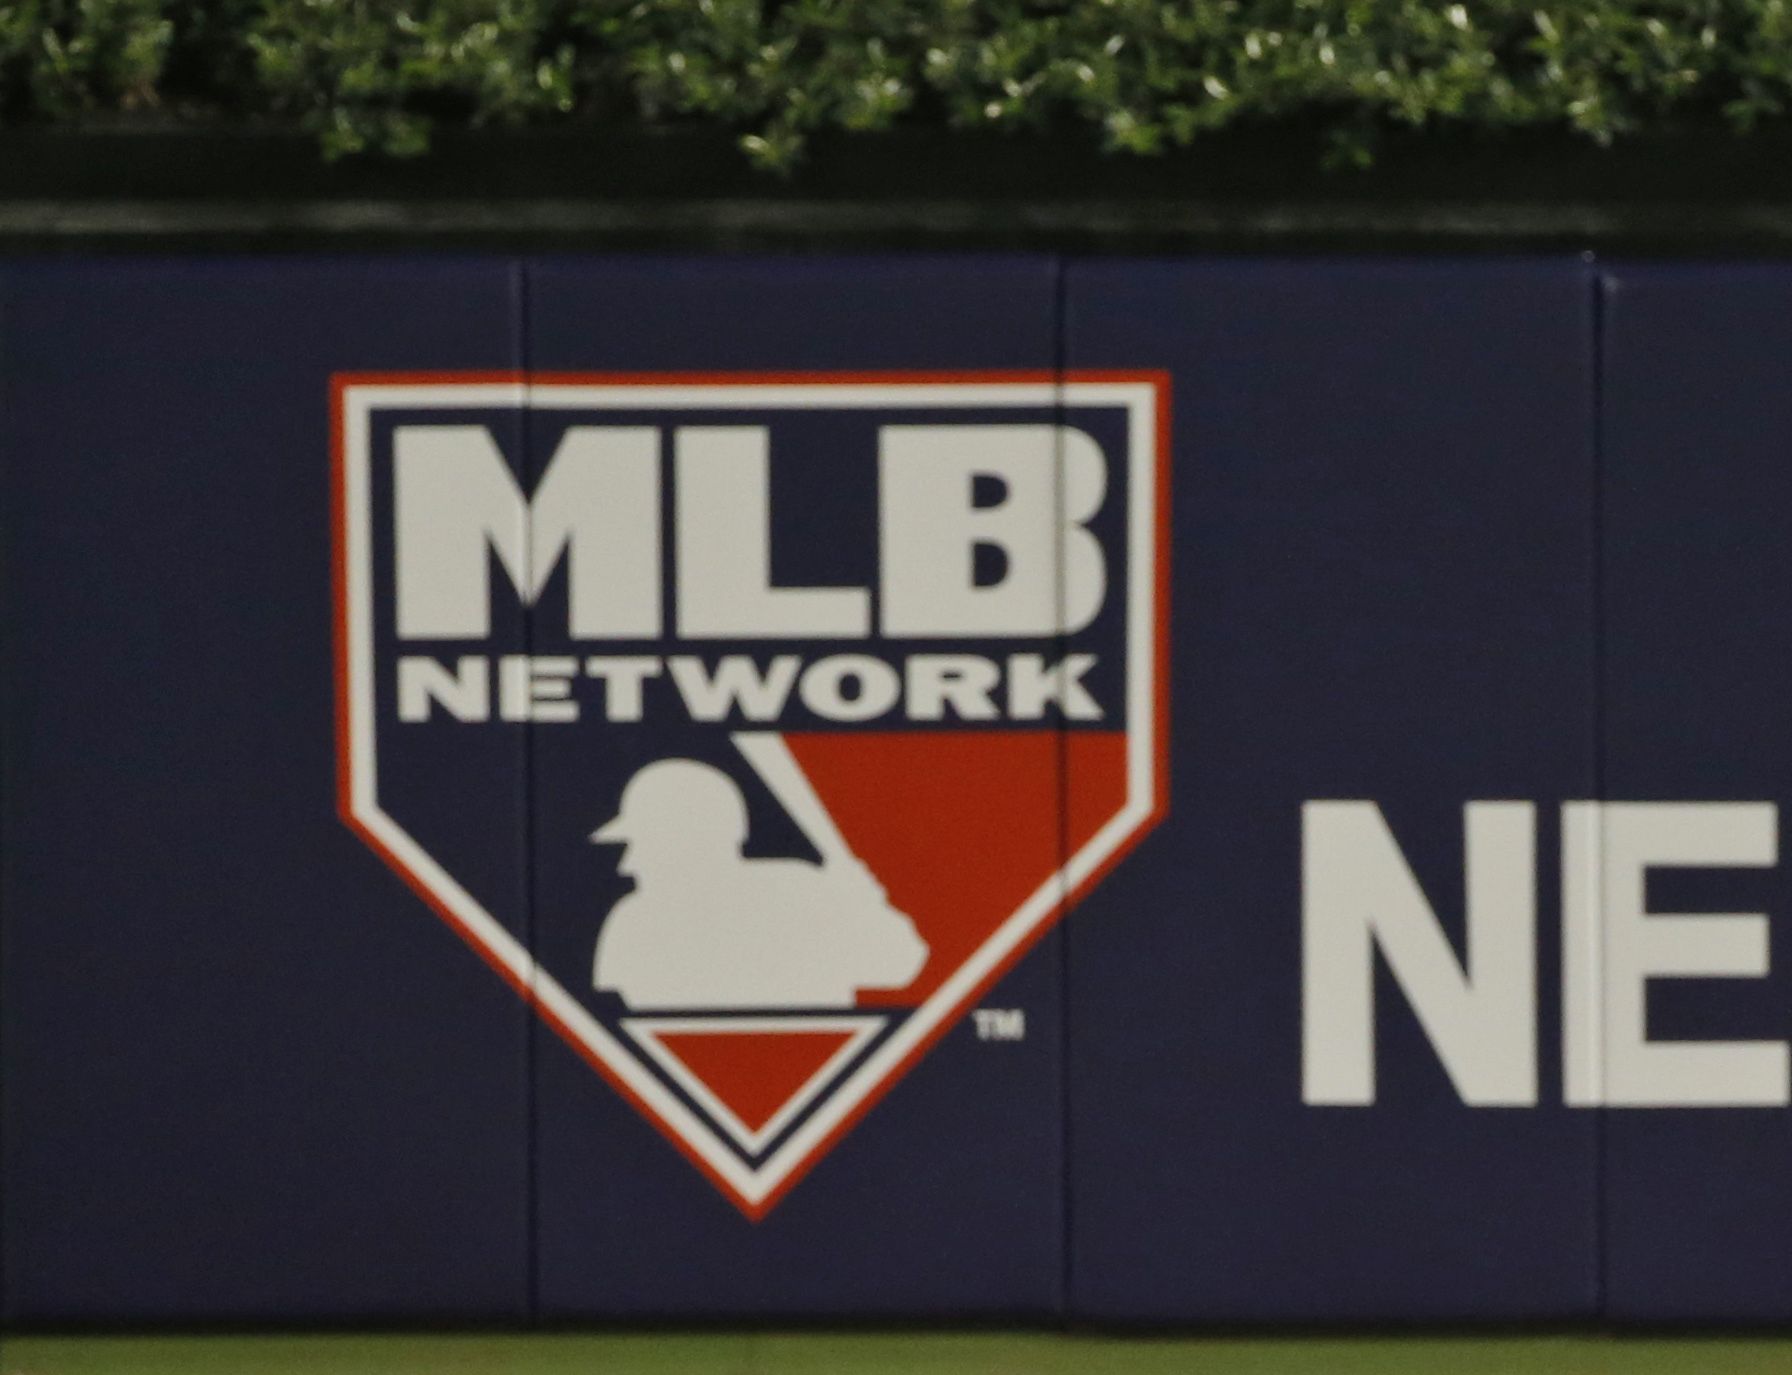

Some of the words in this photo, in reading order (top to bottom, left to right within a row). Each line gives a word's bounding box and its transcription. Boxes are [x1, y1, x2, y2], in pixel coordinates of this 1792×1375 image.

[393, 424, 1107, 639] MLB
[397, 654, 1103, 722] NETWORK
[973, 1009, 1025, 1040] TM
